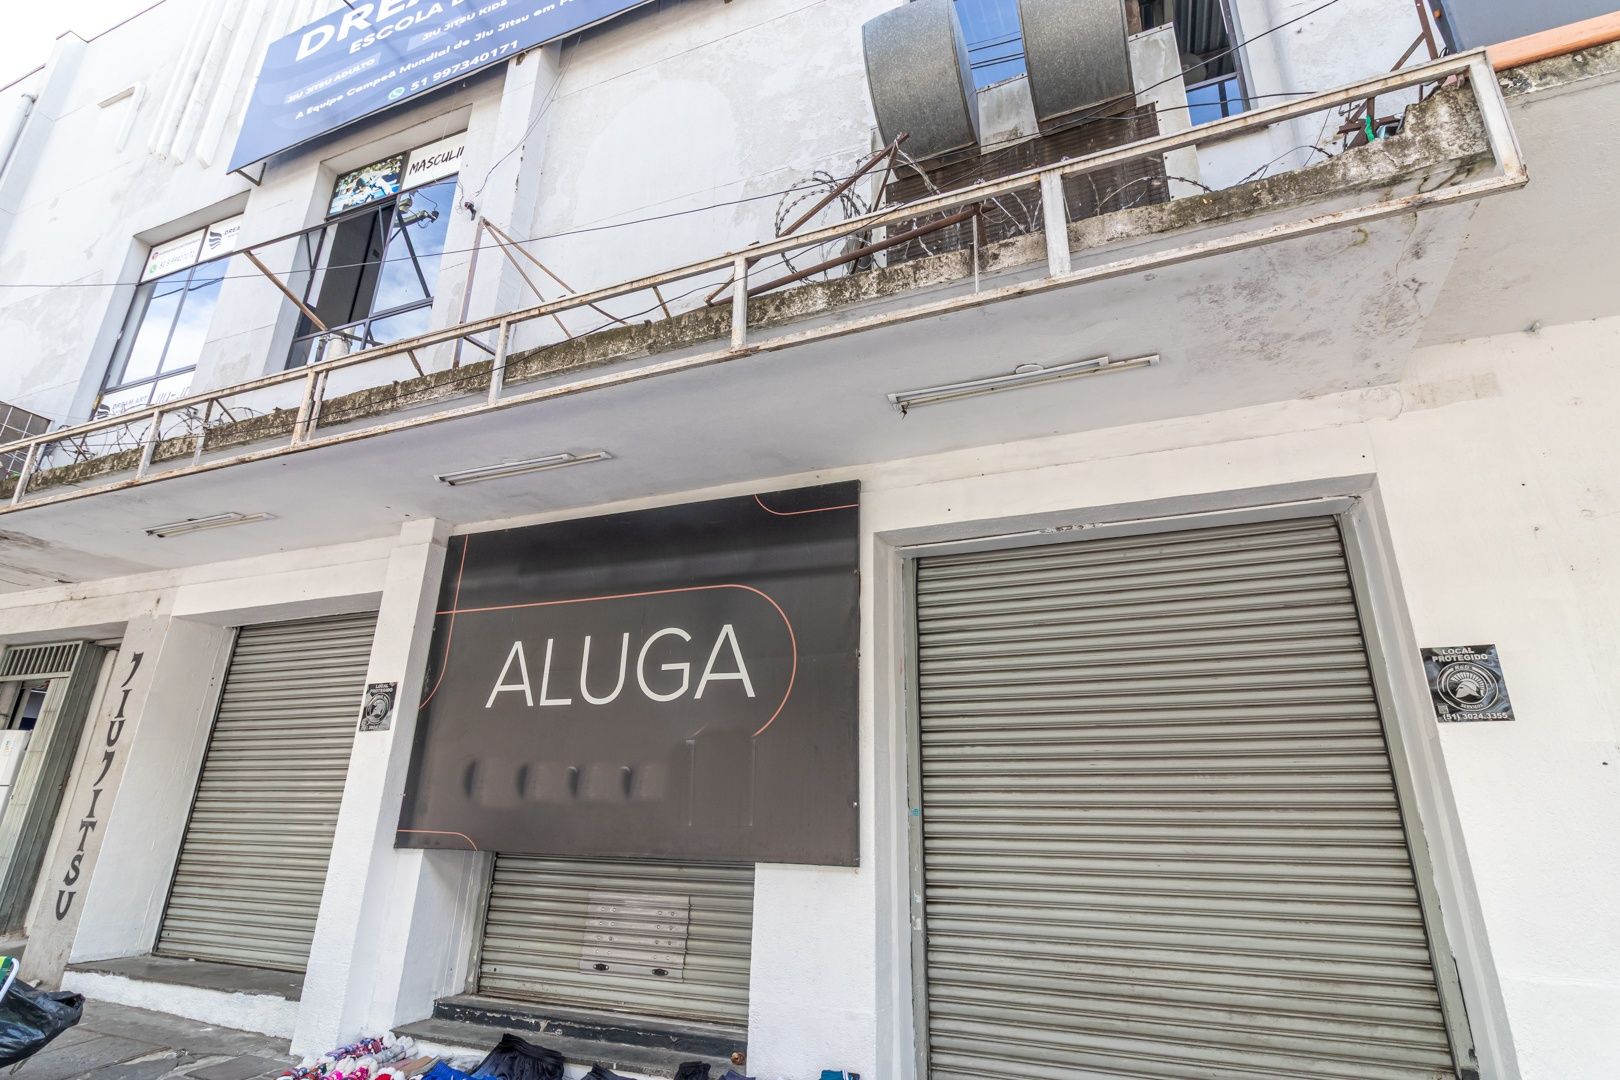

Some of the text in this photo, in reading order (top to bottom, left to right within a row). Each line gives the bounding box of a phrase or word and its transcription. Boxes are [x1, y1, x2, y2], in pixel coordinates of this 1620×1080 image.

[296, 0, 422, 62] DRE
[349, 2, 444, 54] ESCOLA
[422, 27, 441, 41] JIU
[444, 12, 476, 32] JITSU
[478, 0, 508, 16] KIDS
[296, 111, 304, 120] A
[306, 95, 344, 115] Equipe
[400, 45, 450, 74] Mundial
[453, 39, 470, 50] de
[473, 29, 494, 42] Jiu
[497, 14, 530, 32] Jitsu
[533, 4, 556, 17] em
[334, 58, 376, 81] ADULTO
[410, 40, 518, 92] 51 997340171
[485, 623, 756, 708] ALUGA
[1432, 653, 1488, 662] PROTEGIDO
[1442, 647, 1475, 655] LOCAL
